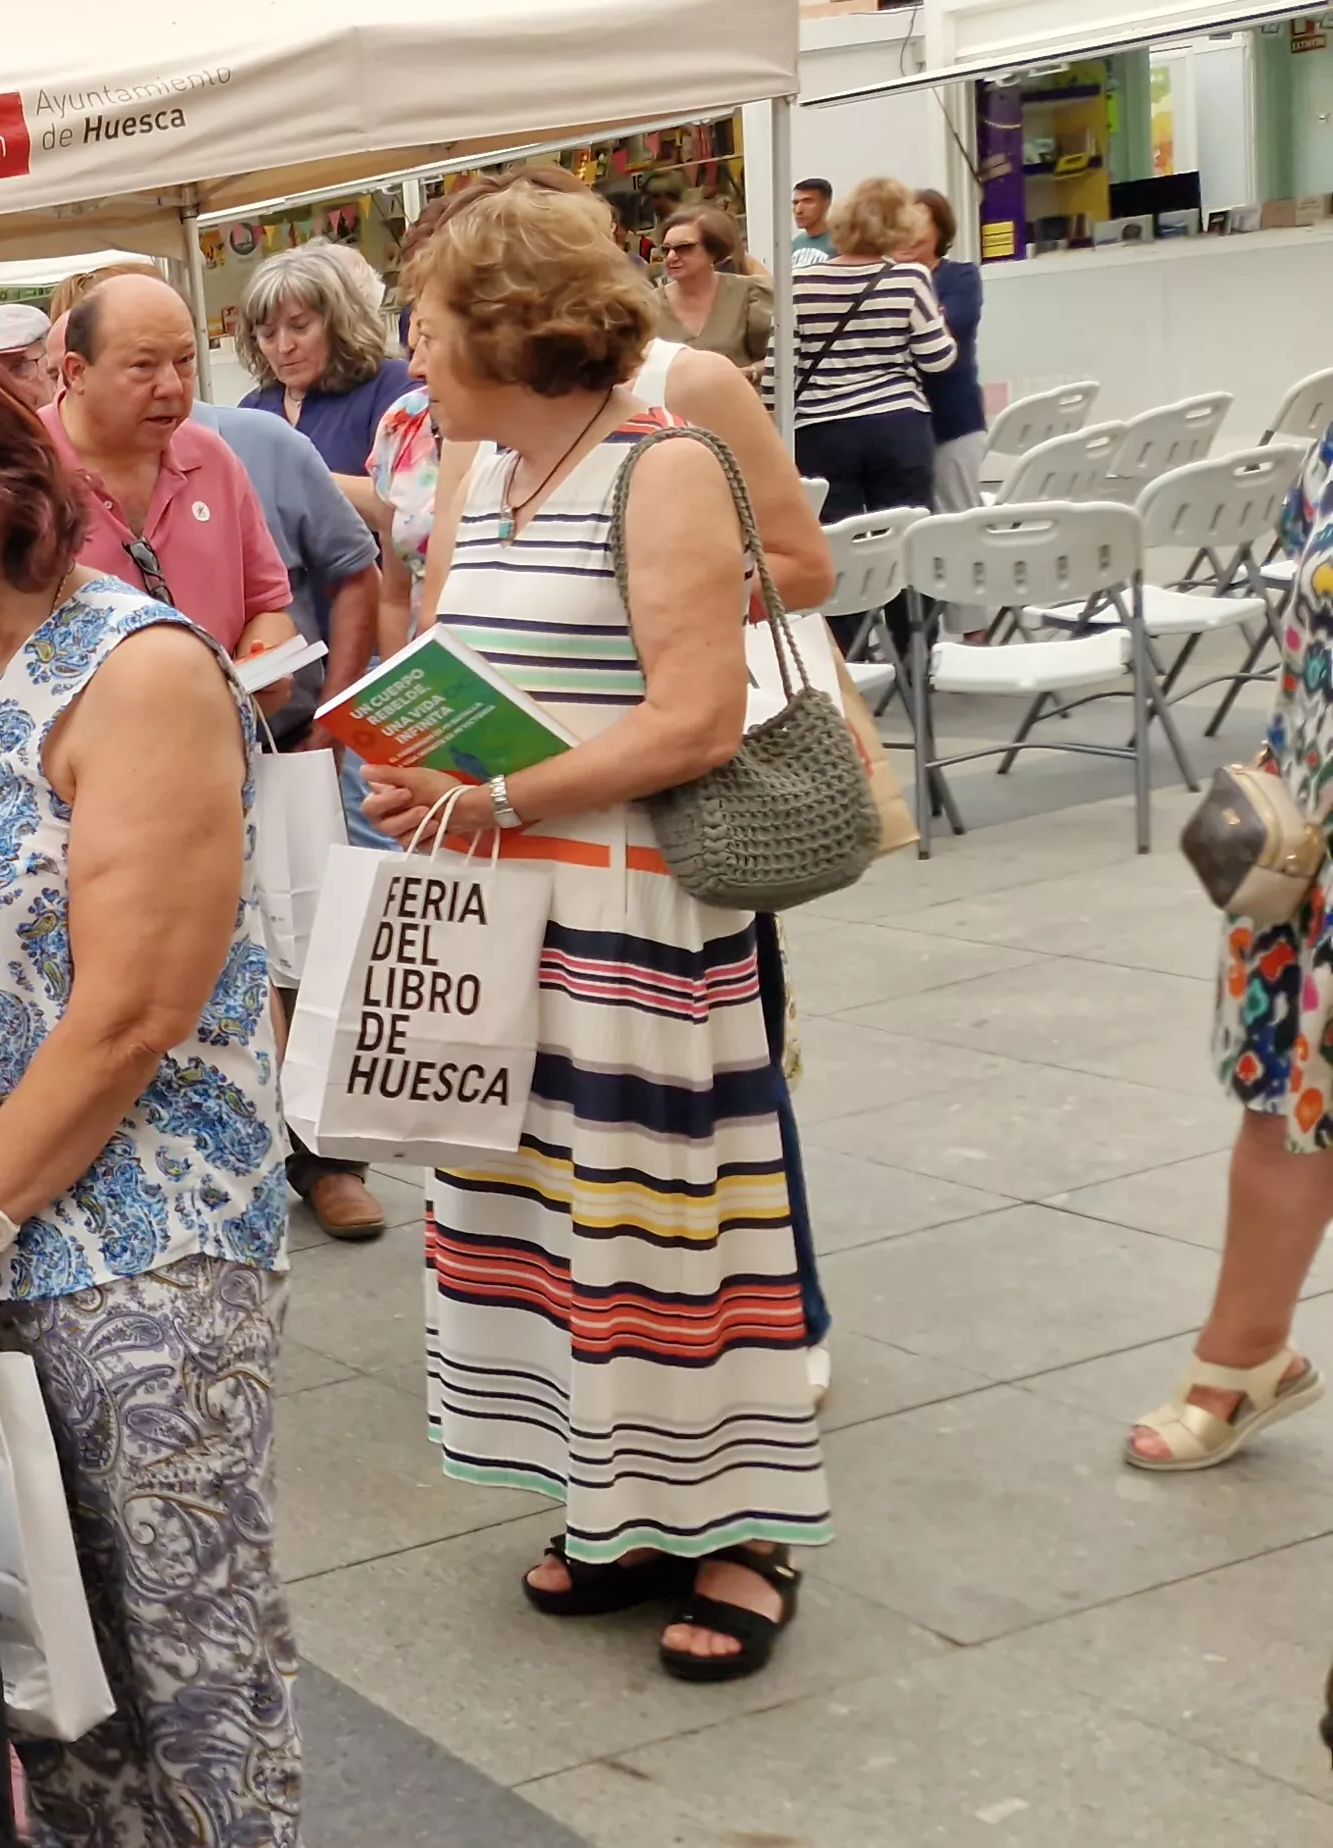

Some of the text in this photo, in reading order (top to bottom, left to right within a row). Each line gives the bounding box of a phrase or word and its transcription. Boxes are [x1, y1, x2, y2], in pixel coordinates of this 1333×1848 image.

[36, 67, 232, 118] Ayuntamiento
[42, 107, 186, 150] de Huesca
[349, 668, 425, 720] UN CUERPO
[366, 683, 432, 726] REBELDE.
[381, 694, 446, 737] UNA VIDA
[393, 706, 454, 744] INFINITA
[383, 876, 487, 925] FERIA
[370, 921, 439, 966] DEL
[363, 965, 482, 1015] LIBRO
[355, 1011, 410, 1055] DE
[346, 1055, 509, 1106] HUESCA
